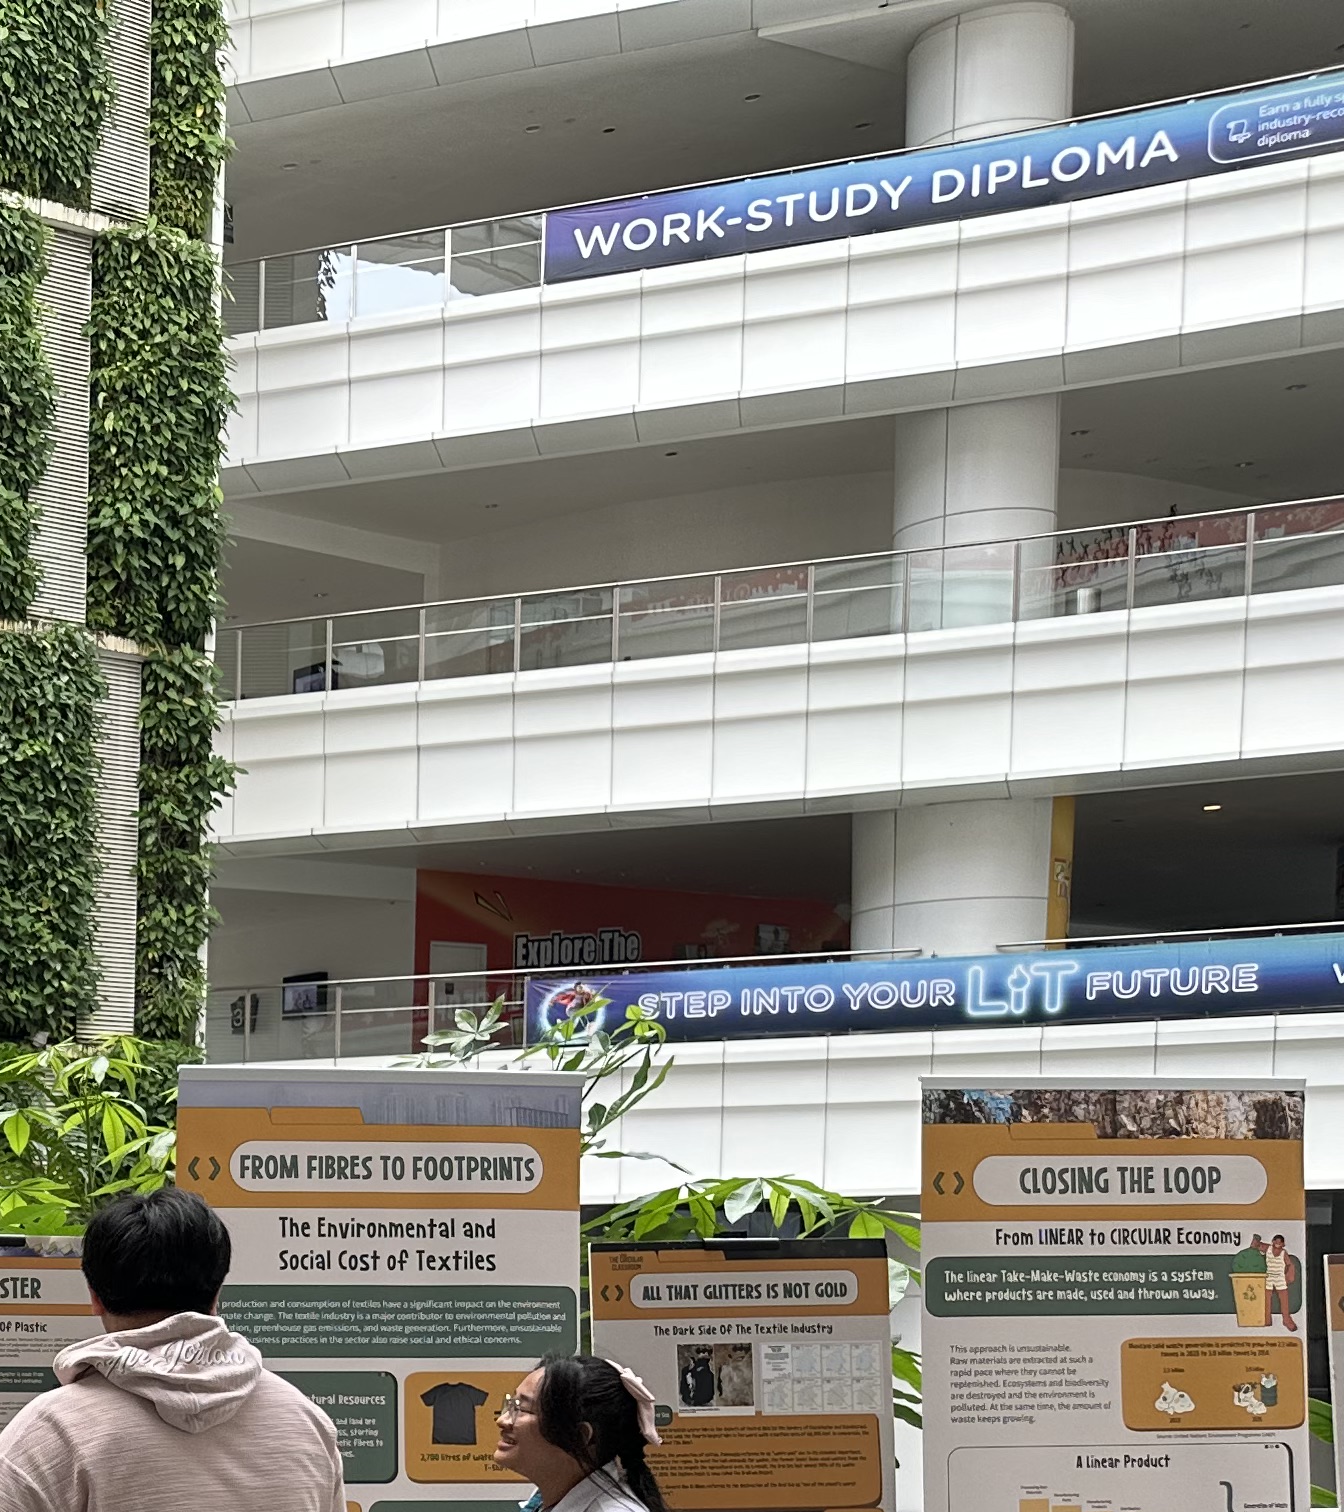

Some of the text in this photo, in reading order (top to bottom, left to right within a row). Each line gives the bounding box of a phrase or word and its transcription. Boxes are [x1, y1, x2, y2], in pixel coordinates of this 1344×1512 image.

[1258, 95, 1330, 117] Earn a fully
[1257, 127, 1310, 147] diploma
[572, 129, 1179, 261] WORK-STUDY DIPLOMA
[515, 928, 642, 968] Explore The
[637, 989, 732, 1020] STEP
[740, 984, 835, 1016] INTO
[843, 980, 957, 1012] YOUR
[1086, 963, 1259, 1001] FUTURE
[240, 1155, 534, 1181] FROM FIBRES TO FOOTPRINTS
[1020, 1166, 1221, 1194] CLOSING THE LOOP
[279, 1217, 495, 1239] The Environmental and
[996, 1228, 1240, 1246] From LINEAR to CIRCULAR Economy
[279, 1250, 496, 1271] Social Cost of Textiles
[945, 1271, 963, 1283] The
[1001, 1270, 1099, 1282] Take-Make-Waste
[1103, 1272, 1145, 1283] economy
[1149, 1272, 1158, 1281] is
[1161, 1272, 1167, 1281] a
[1171, 1269, 1213, 1282] system
[643, 1282, 847, 1301] ALL THAT GLITTERS IS NOT GOLD
[0, 1321, 12, 1332] Of
[15, 1322, 47, 1332] Plastic
[654, 1323, 832, 1336] The Dark Side Of The Textile Industry
